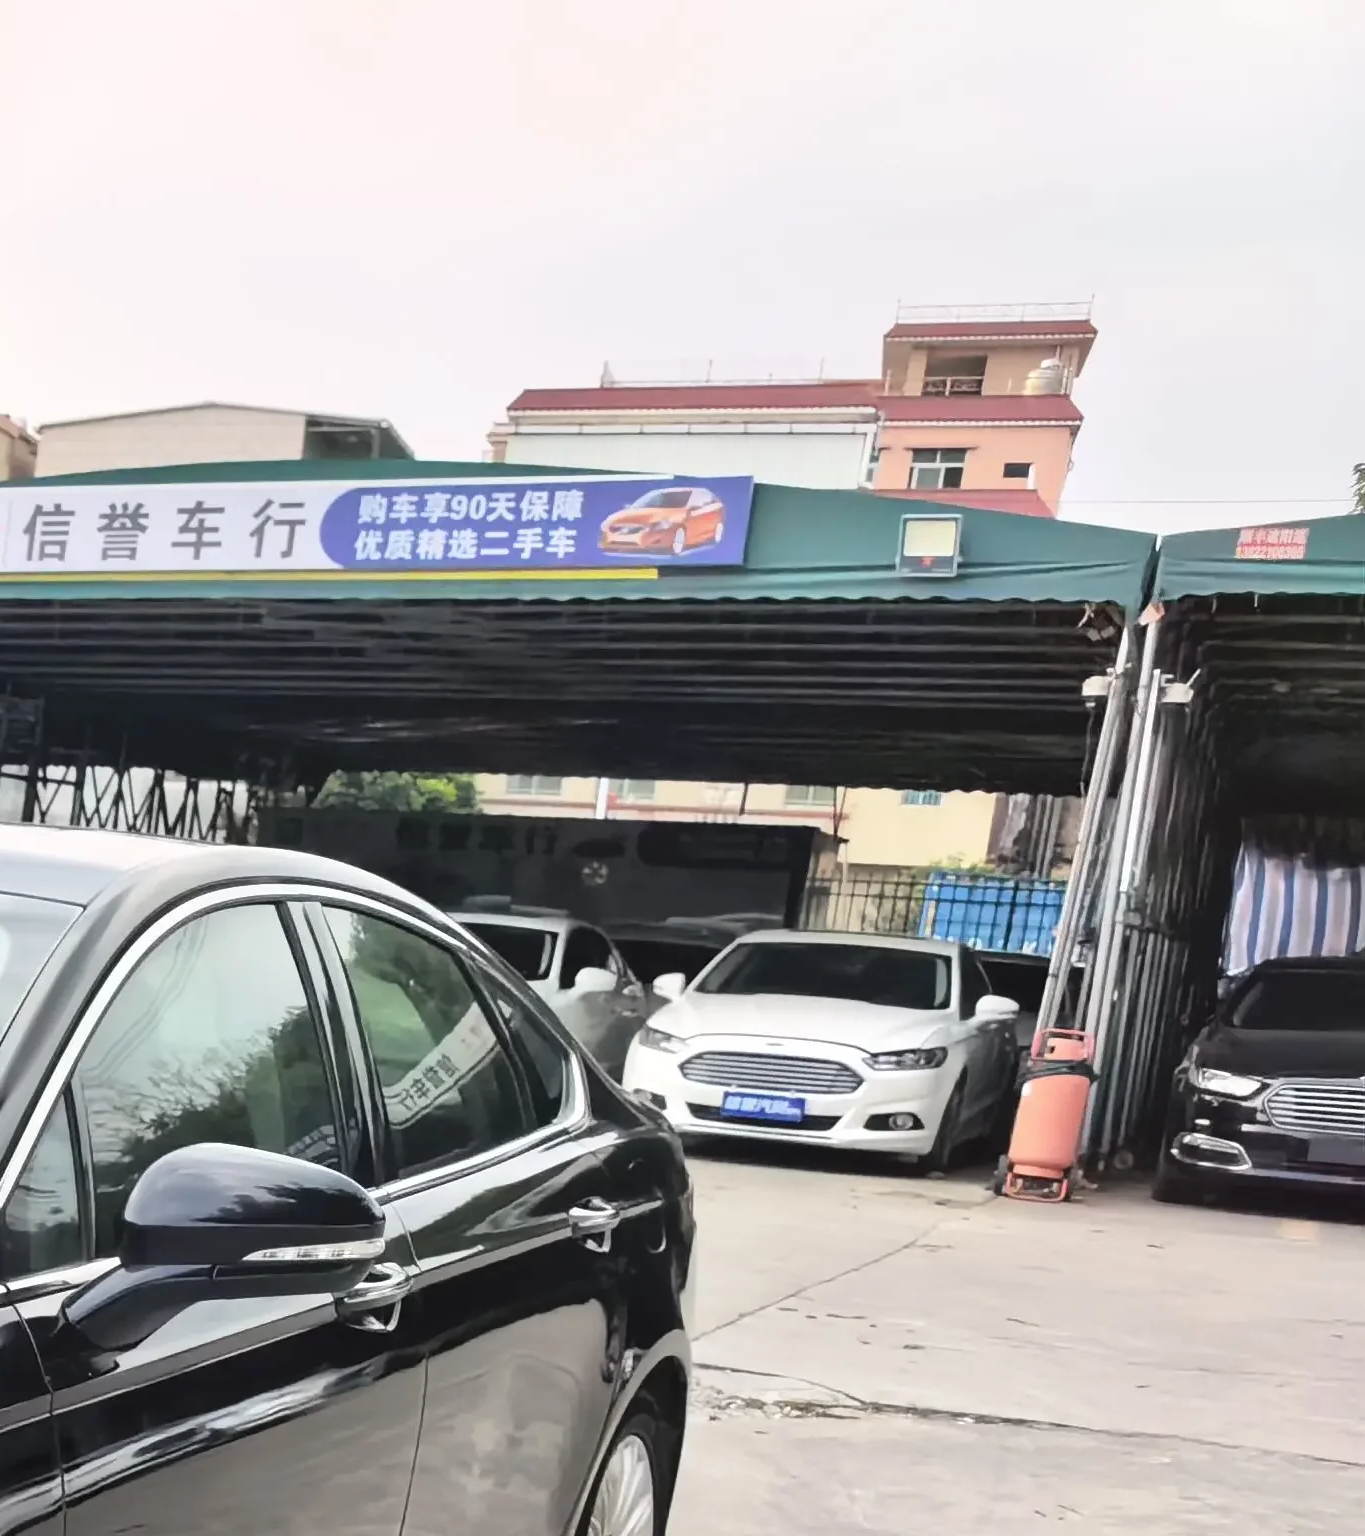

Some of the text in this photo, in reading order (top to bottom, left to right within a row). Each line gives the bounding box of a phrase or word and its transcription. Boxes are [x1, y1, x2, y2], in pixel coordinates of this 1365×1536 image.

[358, 489, 585, 524] 购车享90天保障
[23, 498, 307, 562] 信誉车行
[354, 526, 577, 561] 优质精选二手车
